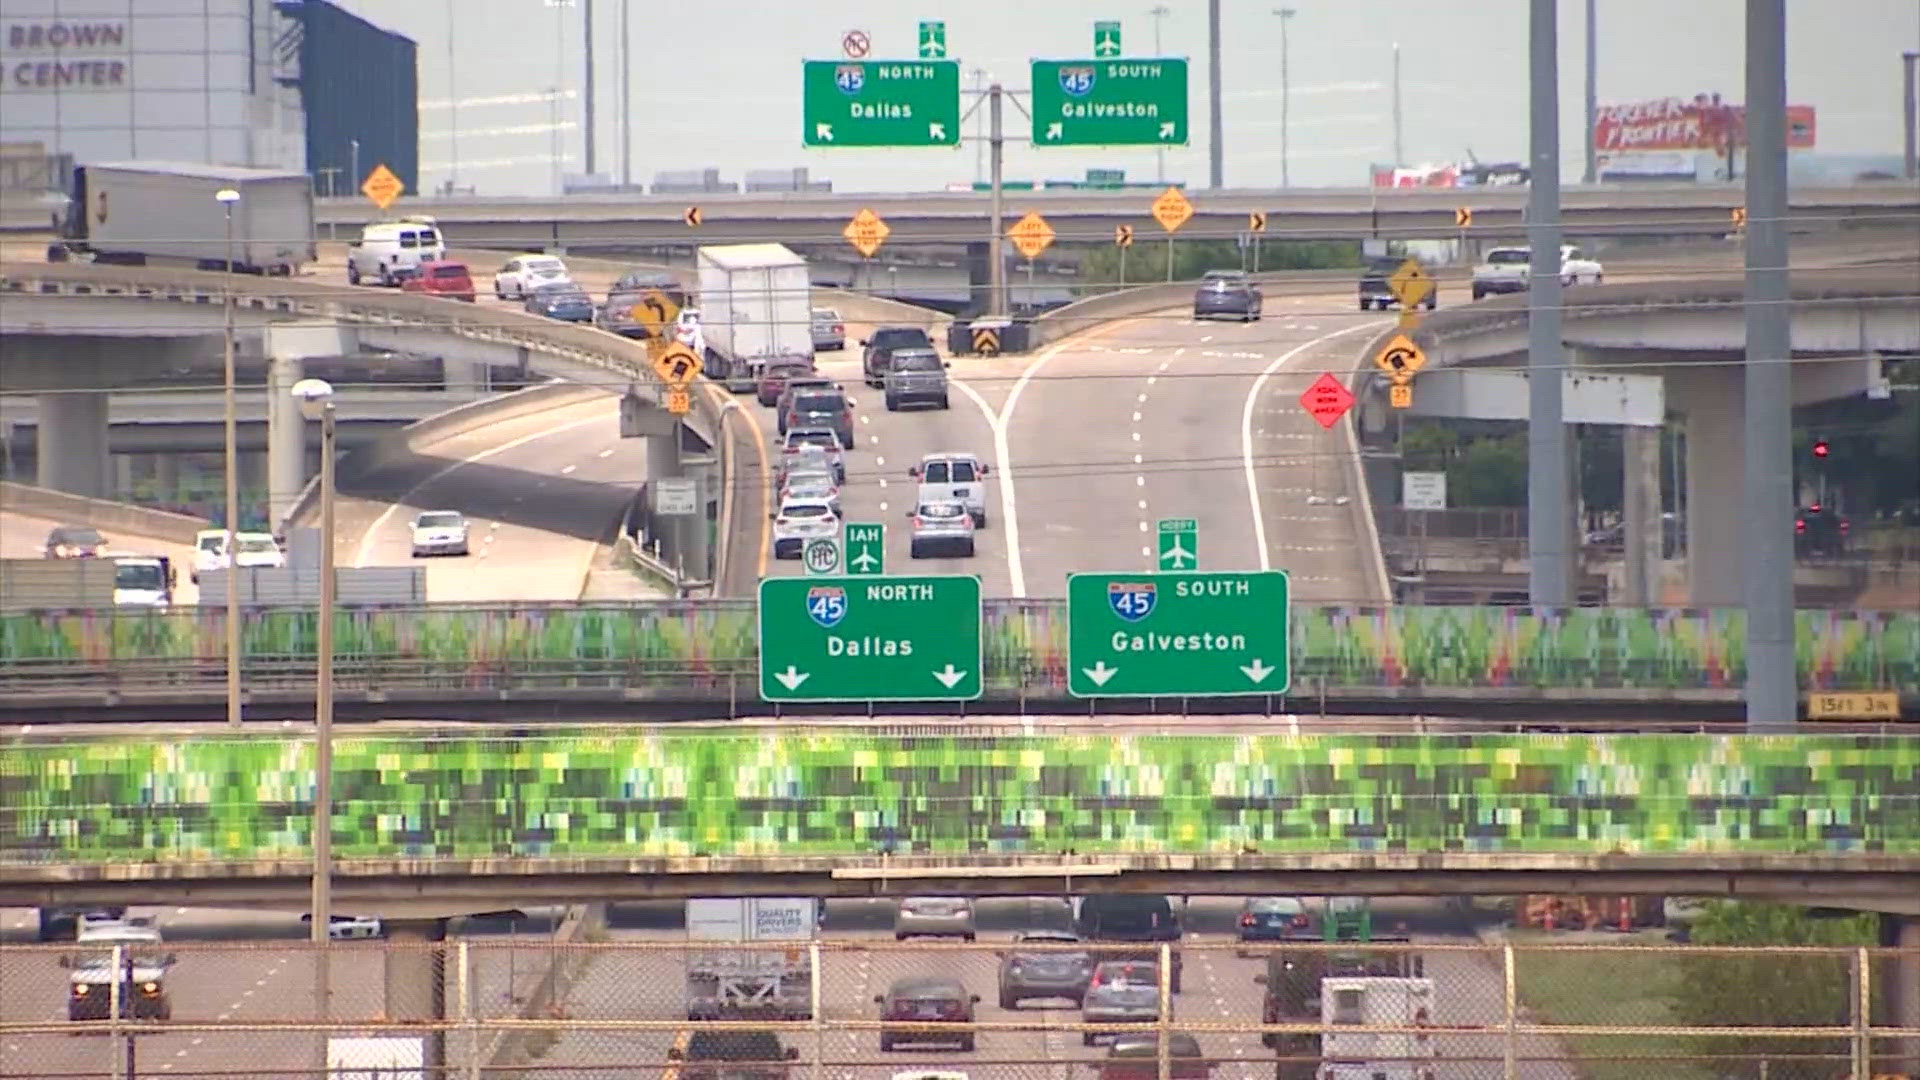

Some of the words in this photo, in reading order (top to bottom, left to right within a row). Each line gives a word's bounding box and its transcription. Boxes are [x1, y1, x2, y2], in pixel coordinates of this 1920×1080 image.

[10, 24, 123, 48] BROWN
[14, 62, 124, 86] CENTER
[838, 72, 862, 89] 45
[879, 67, 934, 79] NORTH
[1065, 75, 1090, 91] 45
[1108, 66, 1161, 78] SOUTH
[851, 103, 912, 118] Dallas
[1062, 102, 1158, 118] Galveston
[850, 528, 879, 542] IAH
[811, 596, 842, 619] 45
[867, 584, 934, 601] NORTH
[1116, 592, 1149, 614] 45
[1176, 580, 1250, 597] SOUTH
[827, 636, 913, 657] Dallas
[1111, 631, 1246, 652] Galveston
